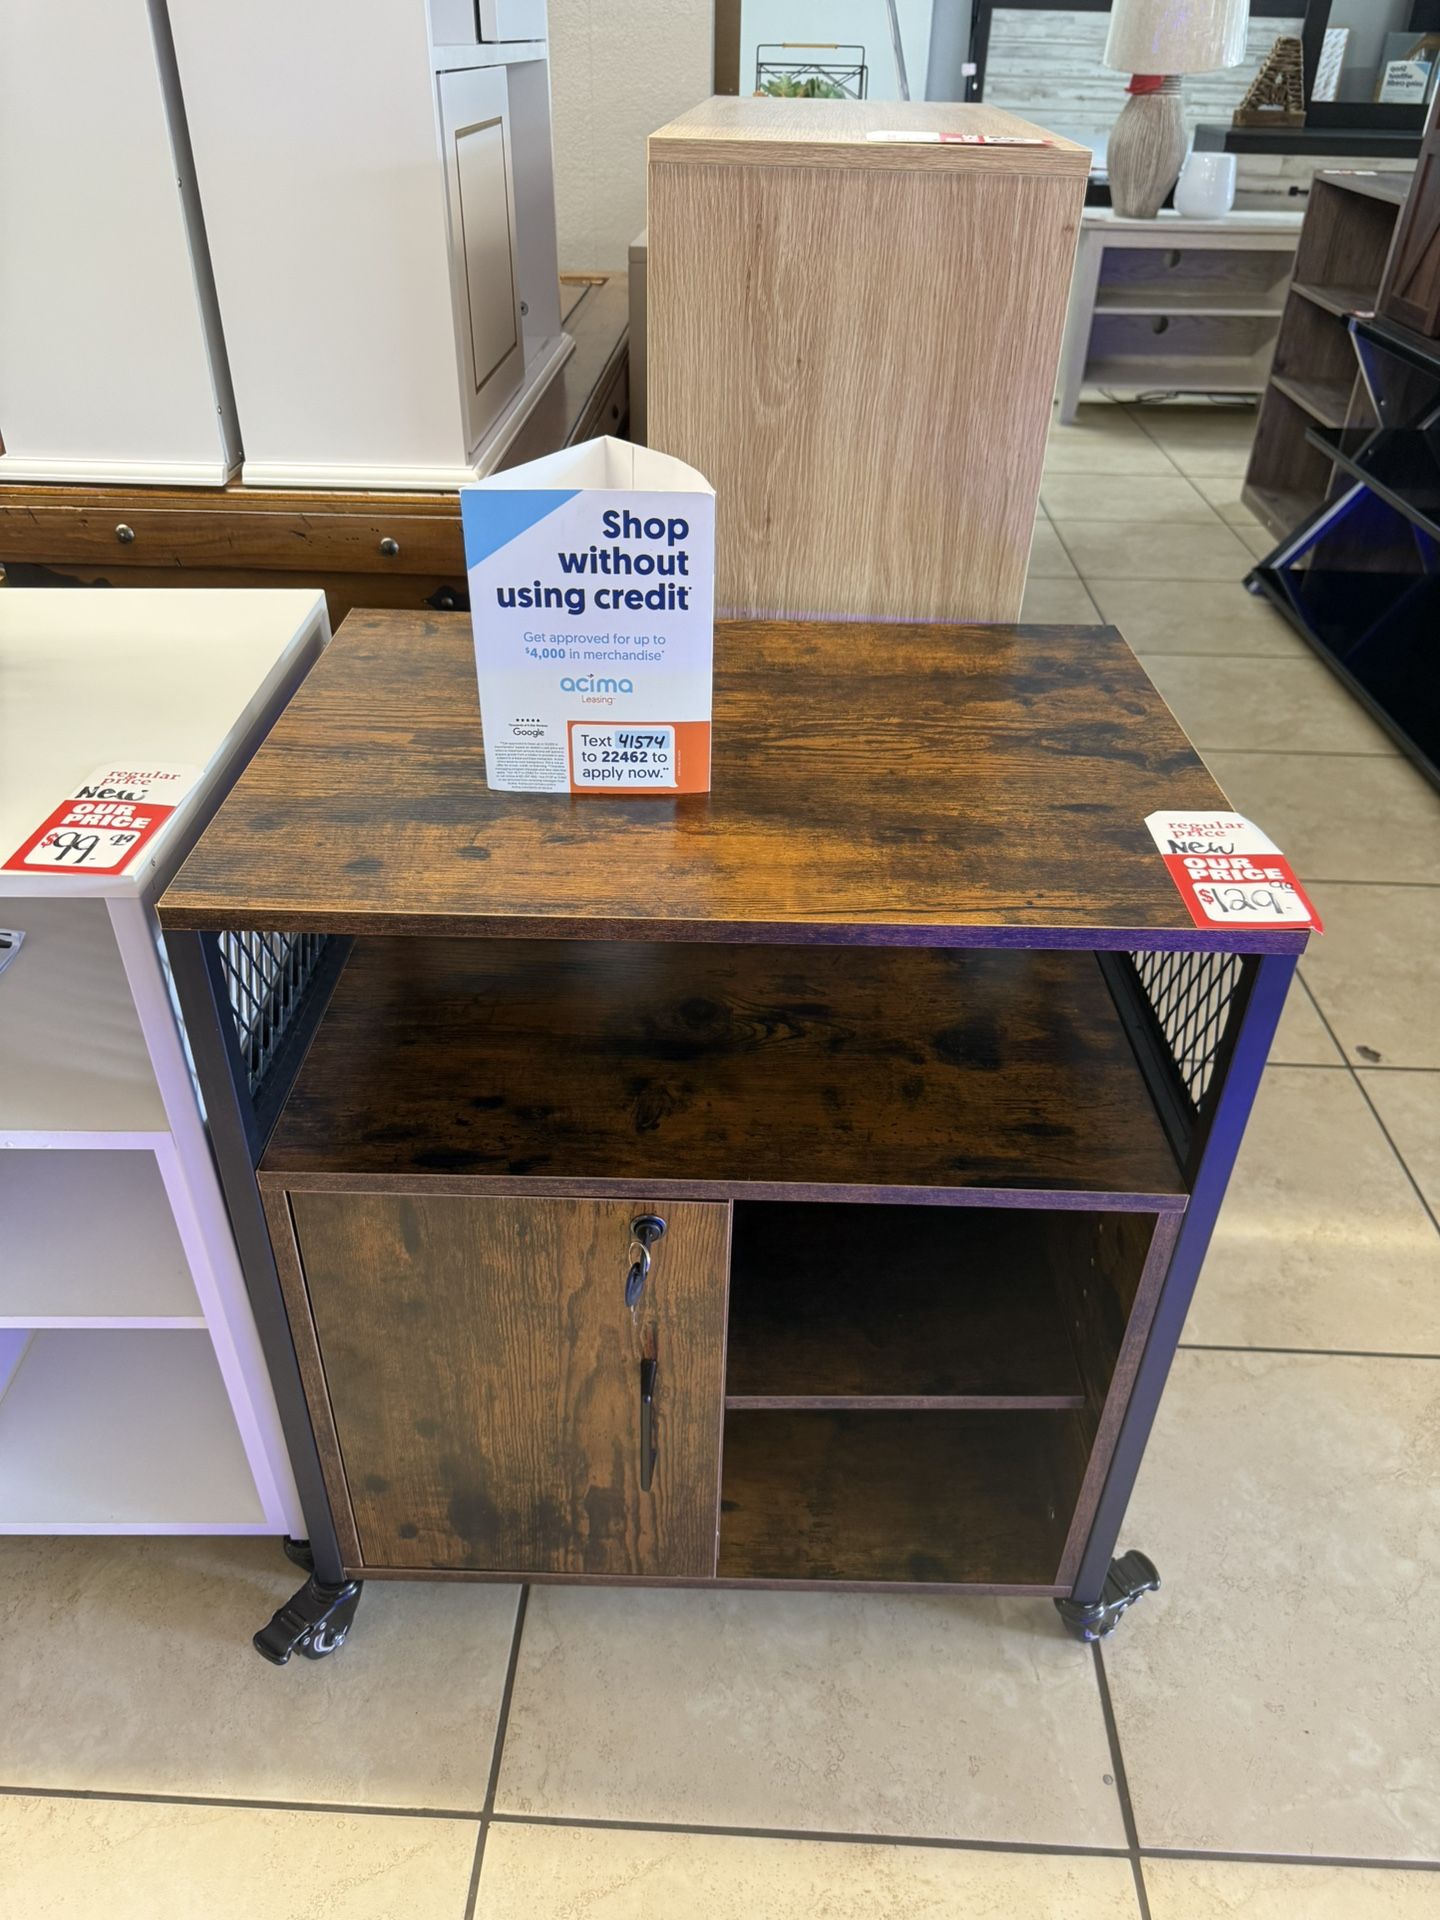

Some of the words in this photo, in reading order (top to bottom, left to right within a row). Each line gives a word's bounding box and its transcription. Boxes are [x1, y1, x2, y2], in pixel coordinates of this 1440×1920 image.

[602, 509, 689, 546] Shop
[558, 545, 689, 576] without
[497, 581, 585, 615] using
[523, 632, 546, 643] Get
[549, 632, 609, 646] approved
[613, 633, 631, 645] for
[634, 635, 650, 648] up
[653, 635, 666, 645] to
[525, 647, 566, 660] $4,000
[569, 648, 581, 659] in
[560, 674, 633, 693] acima
[512, 727, 544, 738] Google
[581, 734, 612, 747] Text
[618, 734, 666, 749] 41574
[582, 751, 597, 763] to
[601, 751, 648, 763] 22462
[652, 751, 667, 763] to
[100, 775, 151, 787] price
[108, 769, 181, 783] regular
[582, 767, 623, 781] apply
[71, 803, 137, 816] OUR
[60, 814, 152, 829] PRICE
[1167, 821, 1244, 833] regular
[1172, 827, 1226, 839] price
[1167, 840, 1234, 855] New
[1183, 857, 1254, 869] OUR
[1187, 868, 1285, 881] PRICE
